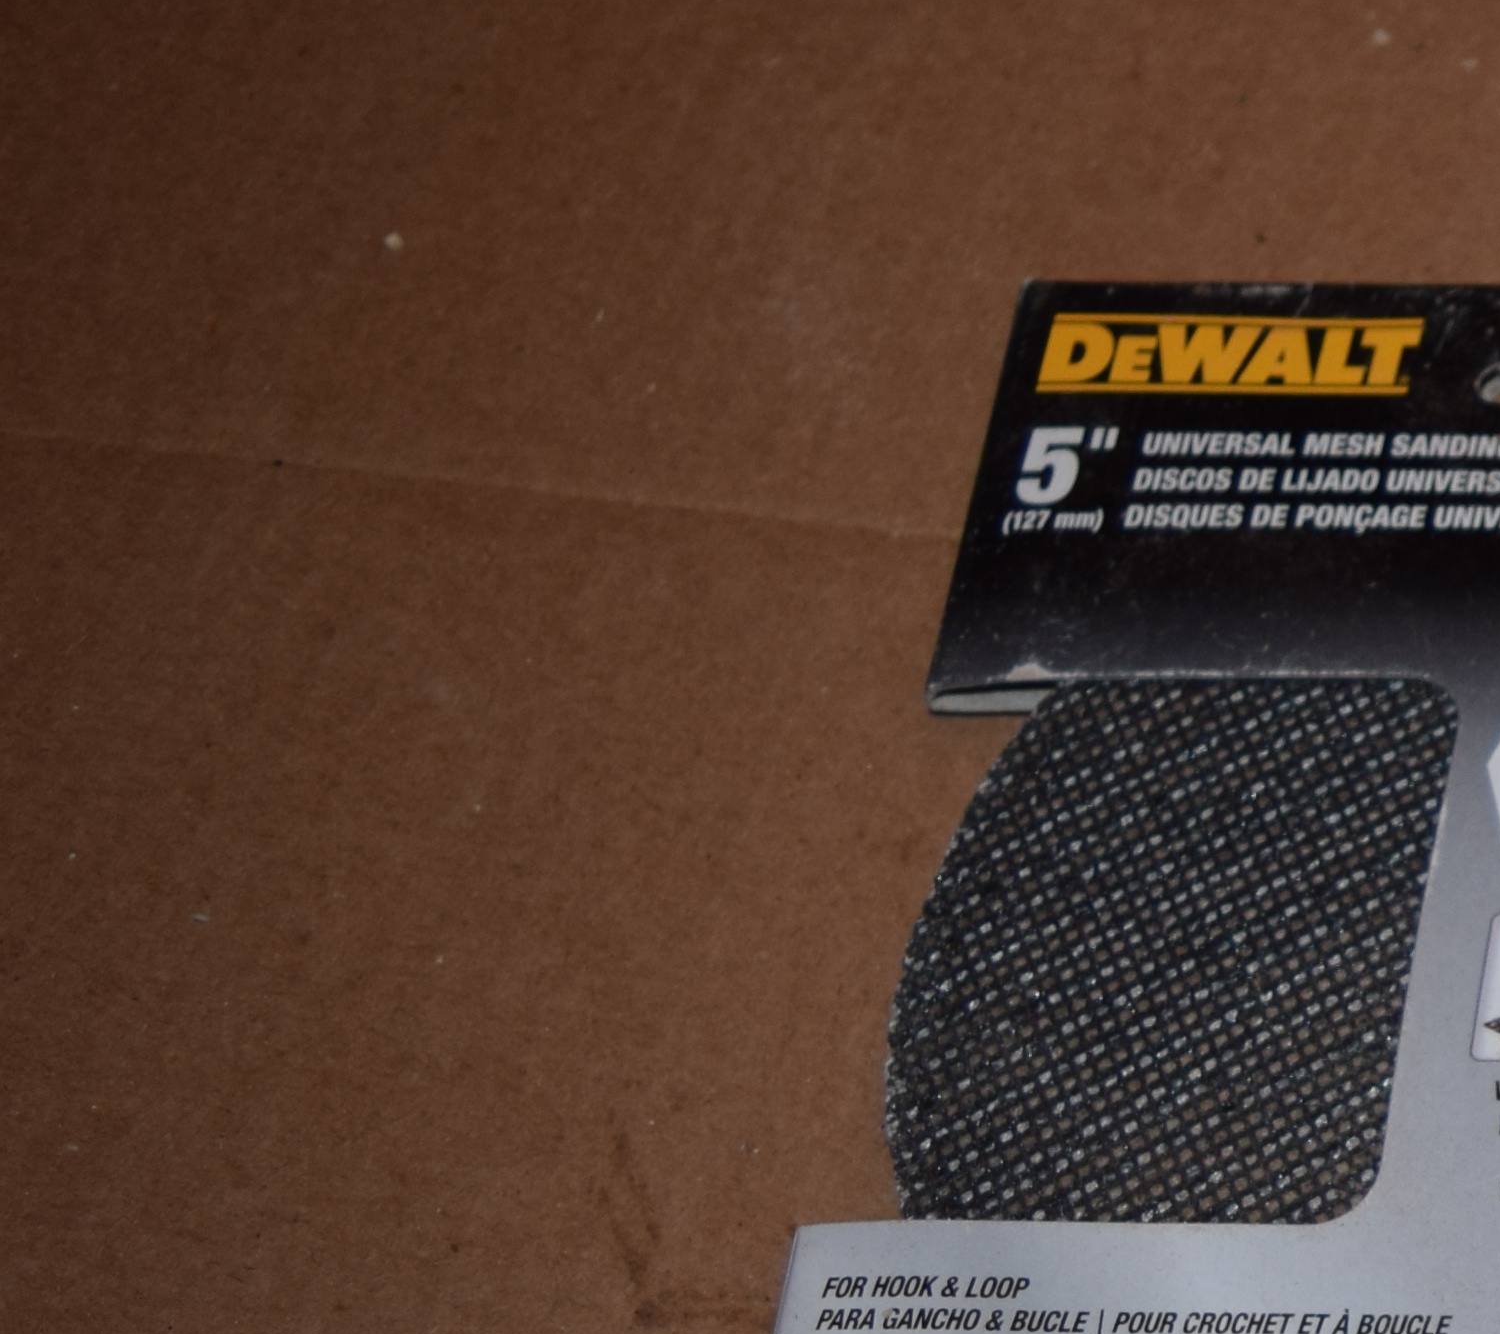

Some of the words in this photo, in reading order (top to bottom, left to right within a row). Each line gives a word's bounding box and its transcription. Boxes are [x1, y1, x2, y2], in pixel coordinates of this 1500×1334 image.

[1141, 432, 1295, 457] UNIVERSAL
[1302, 433, 1384, 458] MESH
[1016, 426, 1119, 505] 5"
[1132, 468, 1232, 493] DISCOS
[1238, 469, 1275, 493] DE
[1281, 469, 1380, 494] LIJADO
[1002, 509, 1052, 534] (127
[1055, 509, 1105, 534] mm)
[1123, 504, 1243, 529] DISQUES
[1250, 505, 1288, 529] DE
[1295, 505, 1428, 535] PONÇAGE
[822, 1276, 866, 1299] FOR
[872, 1276, 937, 1299] HOOK
[941, 1277, 960, 1299] &
[965, 1277, 1031, 1299] LOOP
[815, 1308, 875, 1332] PARA
[881, 1308, 981, 1333] GANCHO
[986, 1309, 1006, 1333] &
[1010, 1310, 1091, 1334] BUCLE
[1111, 1311, 1178, 1334] POUR
